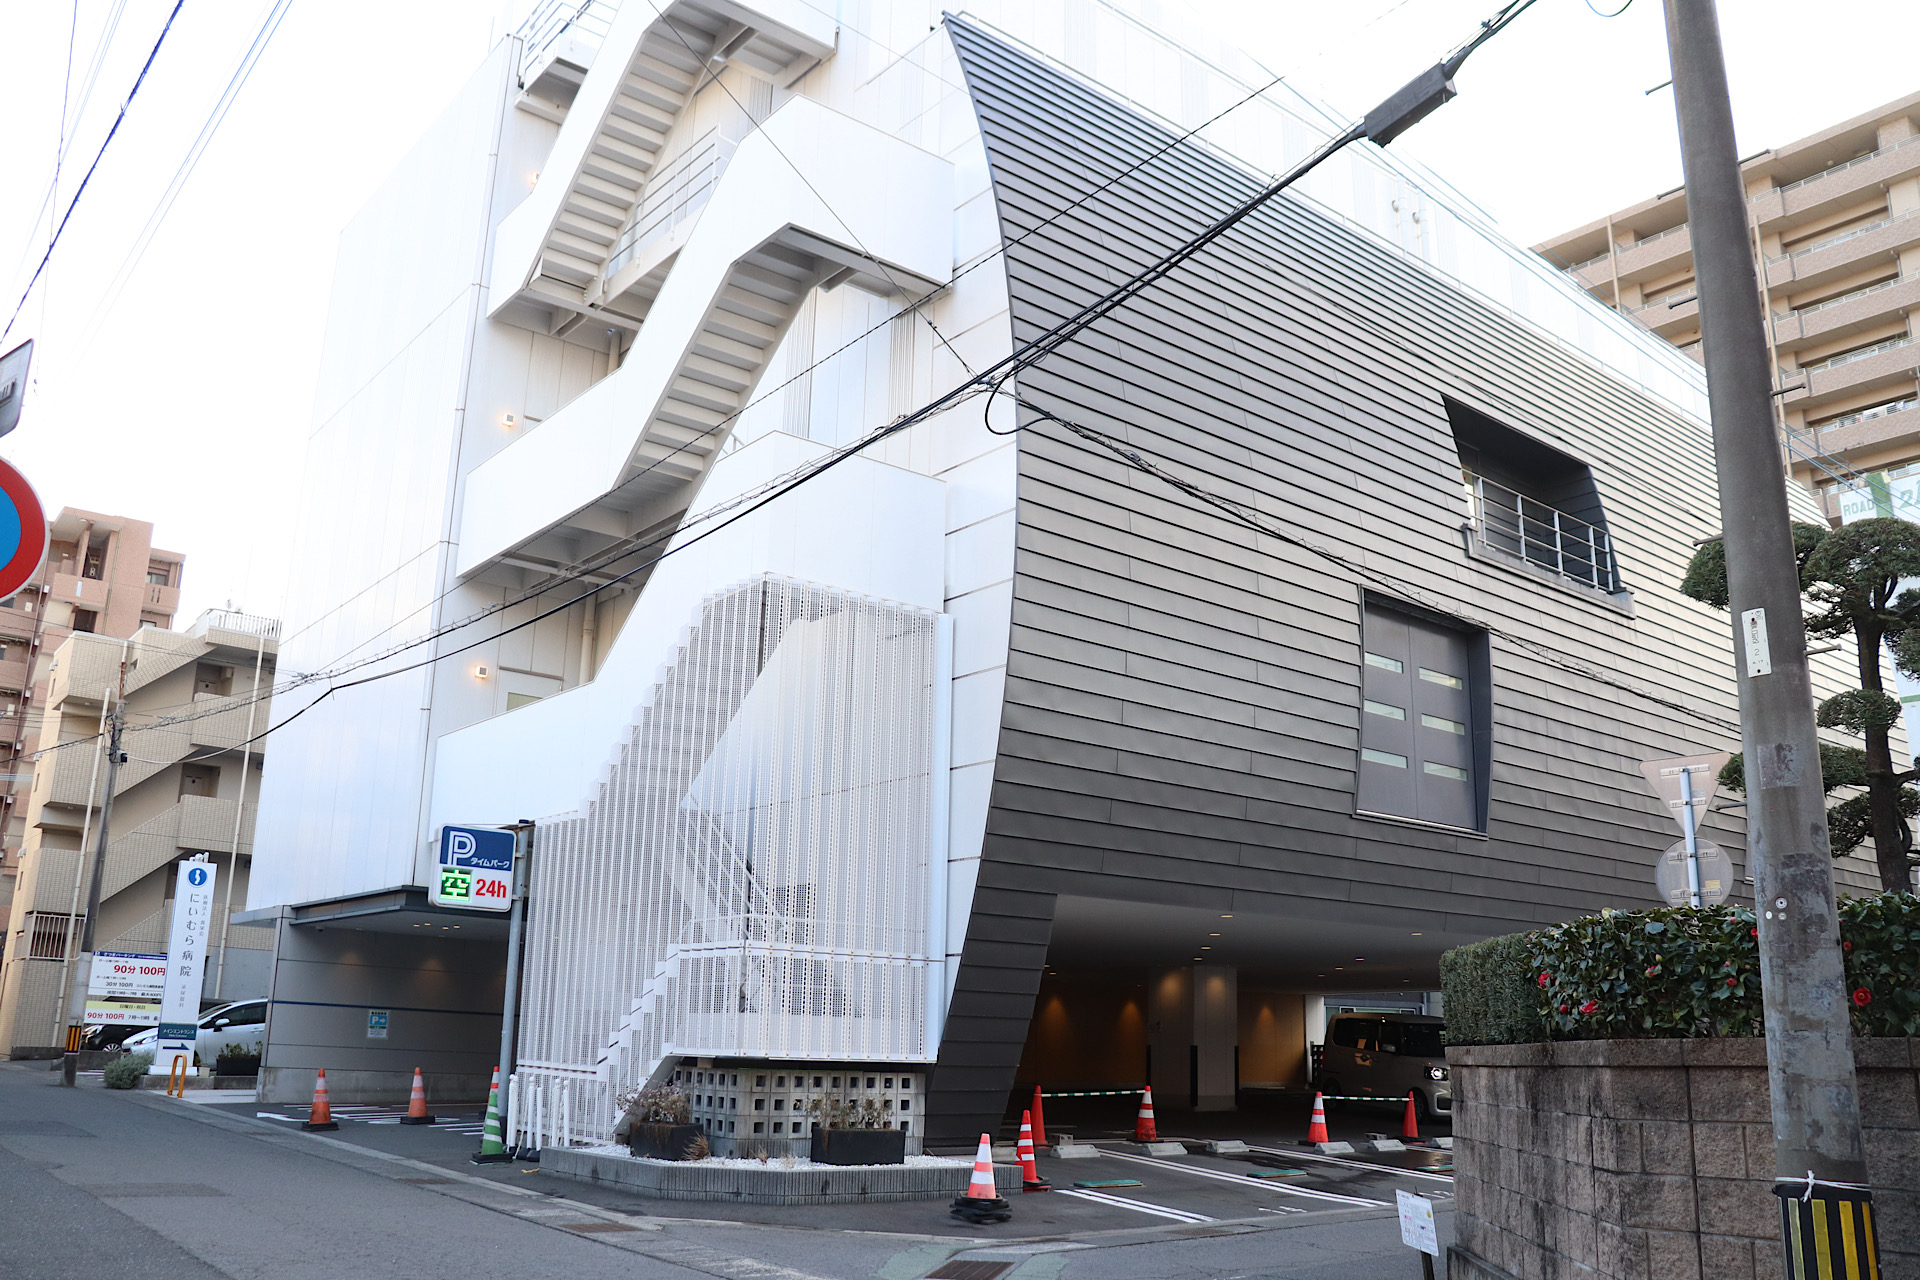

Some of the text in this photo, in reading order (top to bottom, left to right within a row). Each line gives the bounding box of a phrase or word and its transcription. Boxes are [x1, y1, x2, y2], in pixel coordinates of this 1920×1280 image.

[1843, 499, 1875, 517] ROAD
[471, 857, 510, 868] タイムパーク
[440, 869, 471, 902] 空
[475, 878, 507, 898] 24h
[180, 893, 200, 977] にいむら病院
[113, 964, 166, 976] 90分 100円
